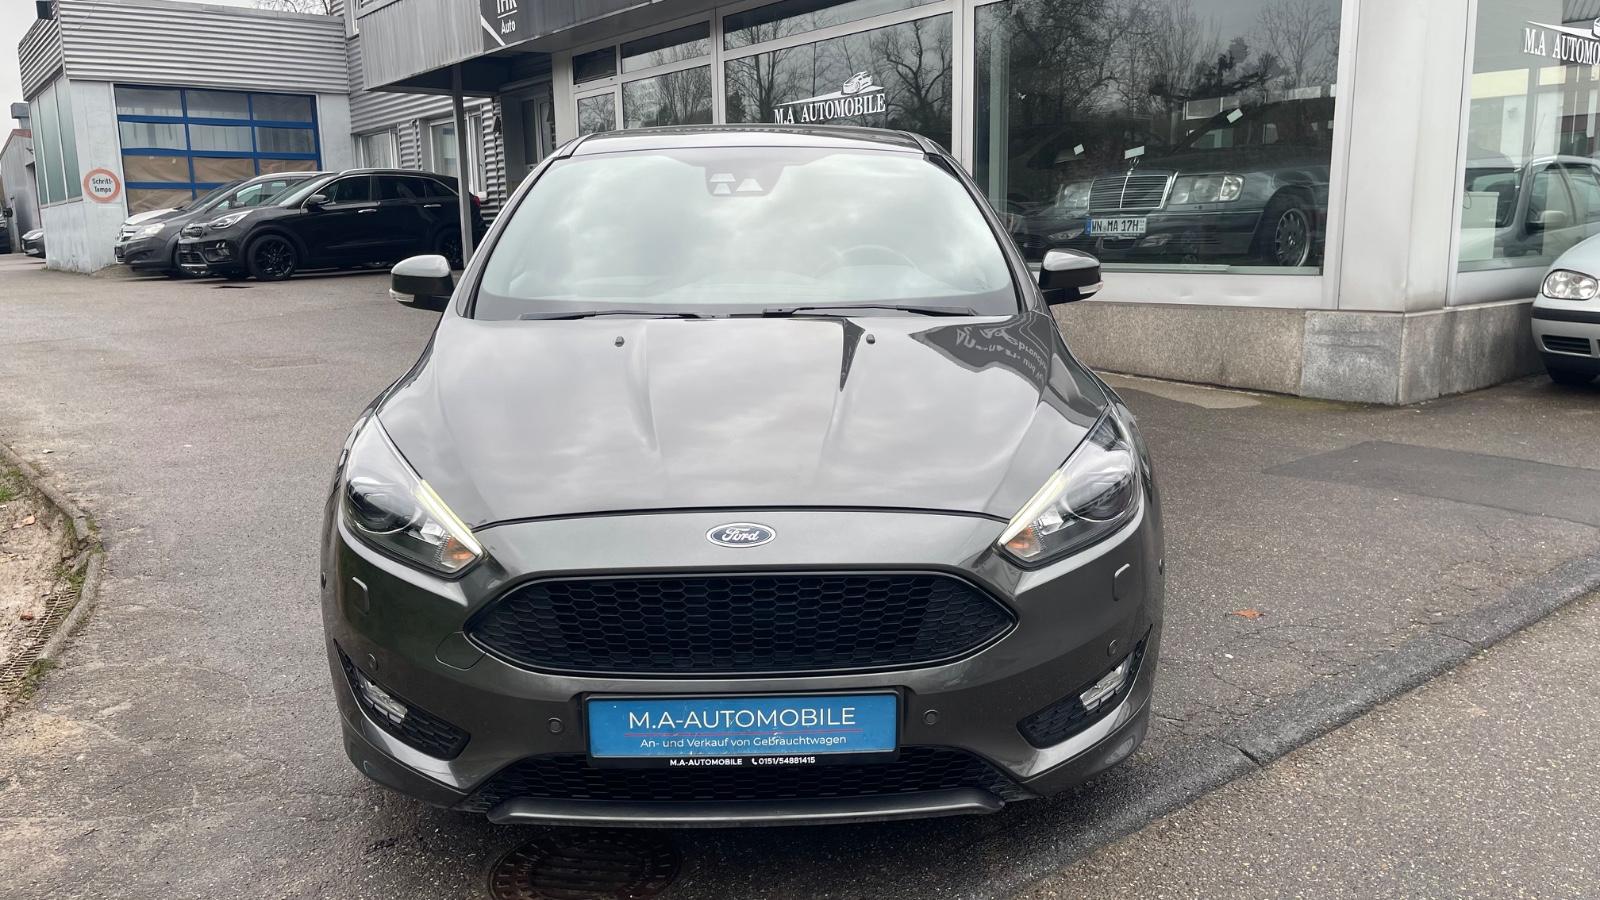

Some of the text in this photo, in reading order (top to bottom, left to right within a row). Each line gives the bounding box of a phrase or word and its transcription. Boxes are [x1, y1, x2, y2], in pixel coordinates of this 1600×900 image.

[501, 20, 516, 35] Auto
[801, 93, 886, 123] AUTOMOBILE
[721, 527, 761, 541] Ford
[629, 707, 856, 729] M.A-AUTOMOBILE
[640, 735, 847, 748] An- und Verkauf von Gebrauchtwagen
[669, 756, 816, 766] M.A-AUTOMOBILE 0151/54881415
